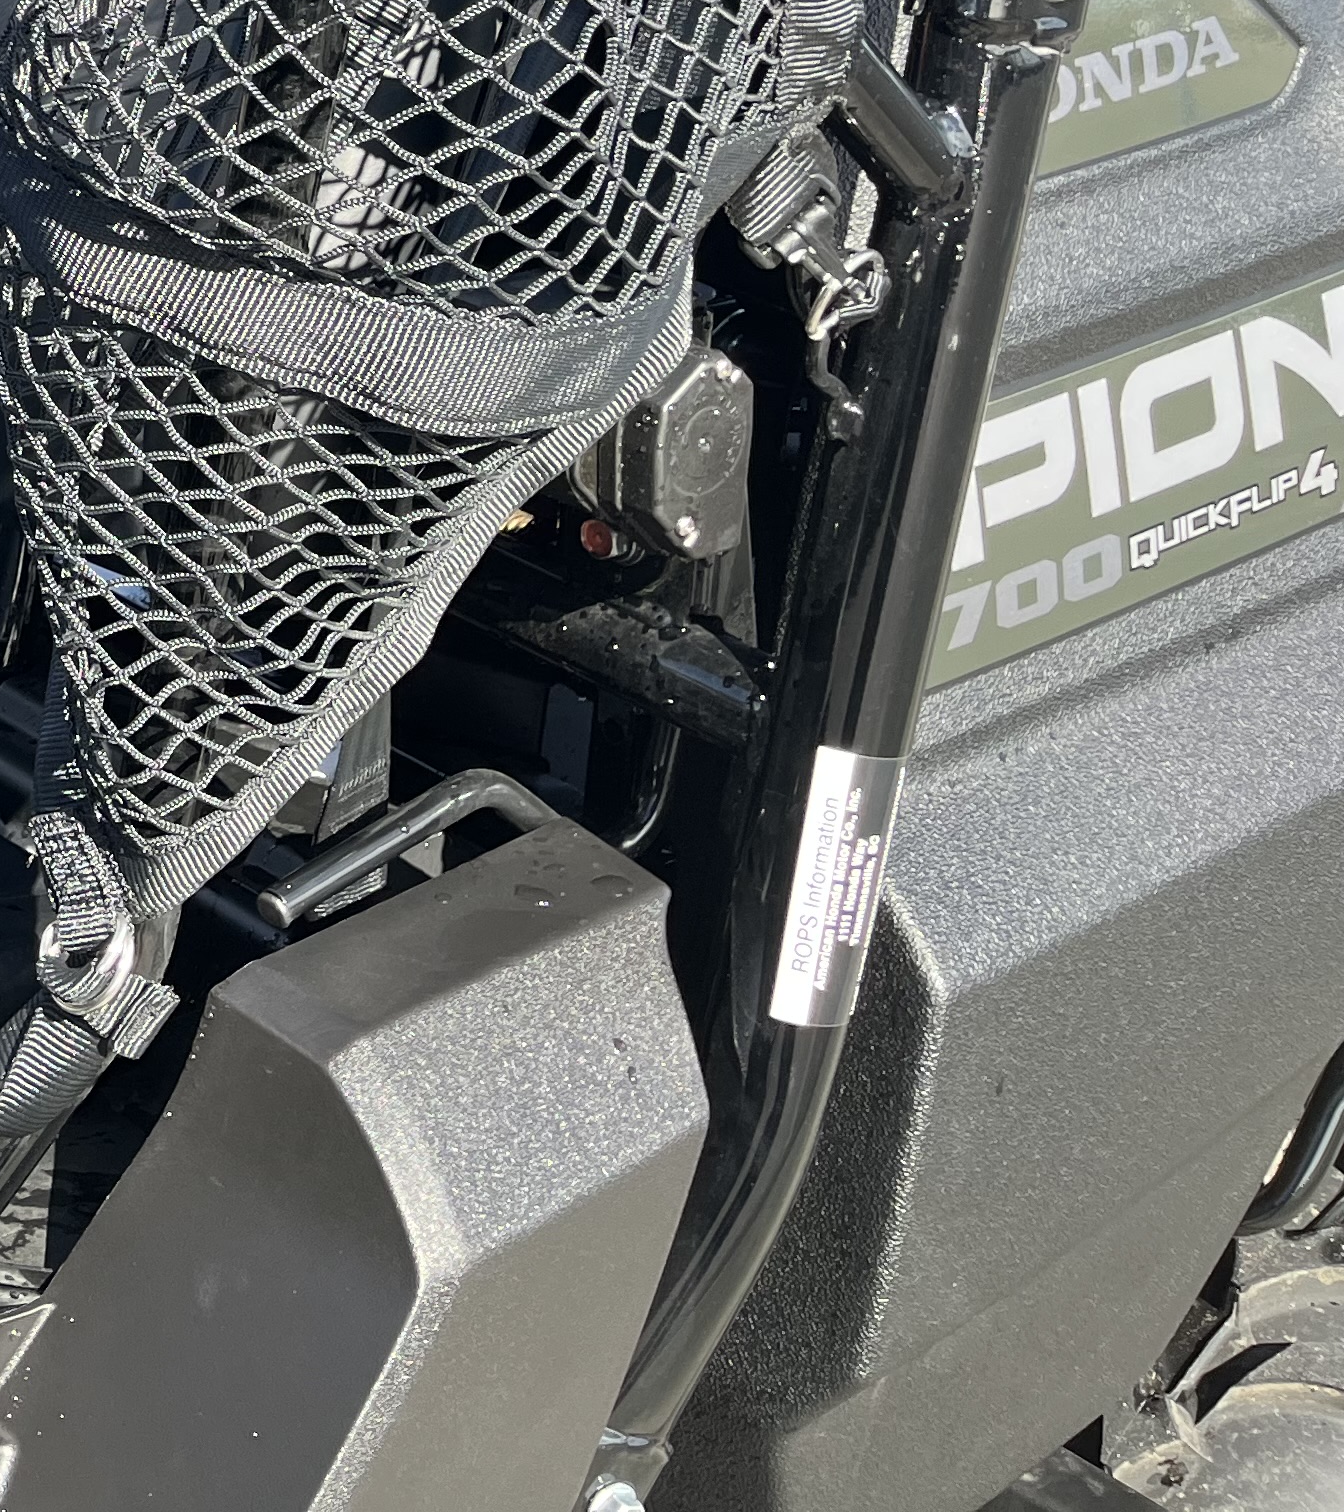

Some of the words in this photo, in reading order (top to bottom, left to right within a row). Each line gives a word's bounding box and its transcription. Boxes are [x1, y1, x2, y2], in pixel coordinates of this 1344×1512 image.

[951, 286, 1344, 572] PION
[942, 533, 1123, 651] 700
[846, 787, 863, 812] Inc.
[833, 844, 852, 881] Motor
[851, 838, 869, 867] Way
[791, 914, 818, 973] ROPS
[810, 797, 839, 910] Information
[825, 883, 844, 927] Honda
[843, 869, 862, 911] Honda
[837, 914, 853, 942] 1111
[814, 929, 836, 991] American
